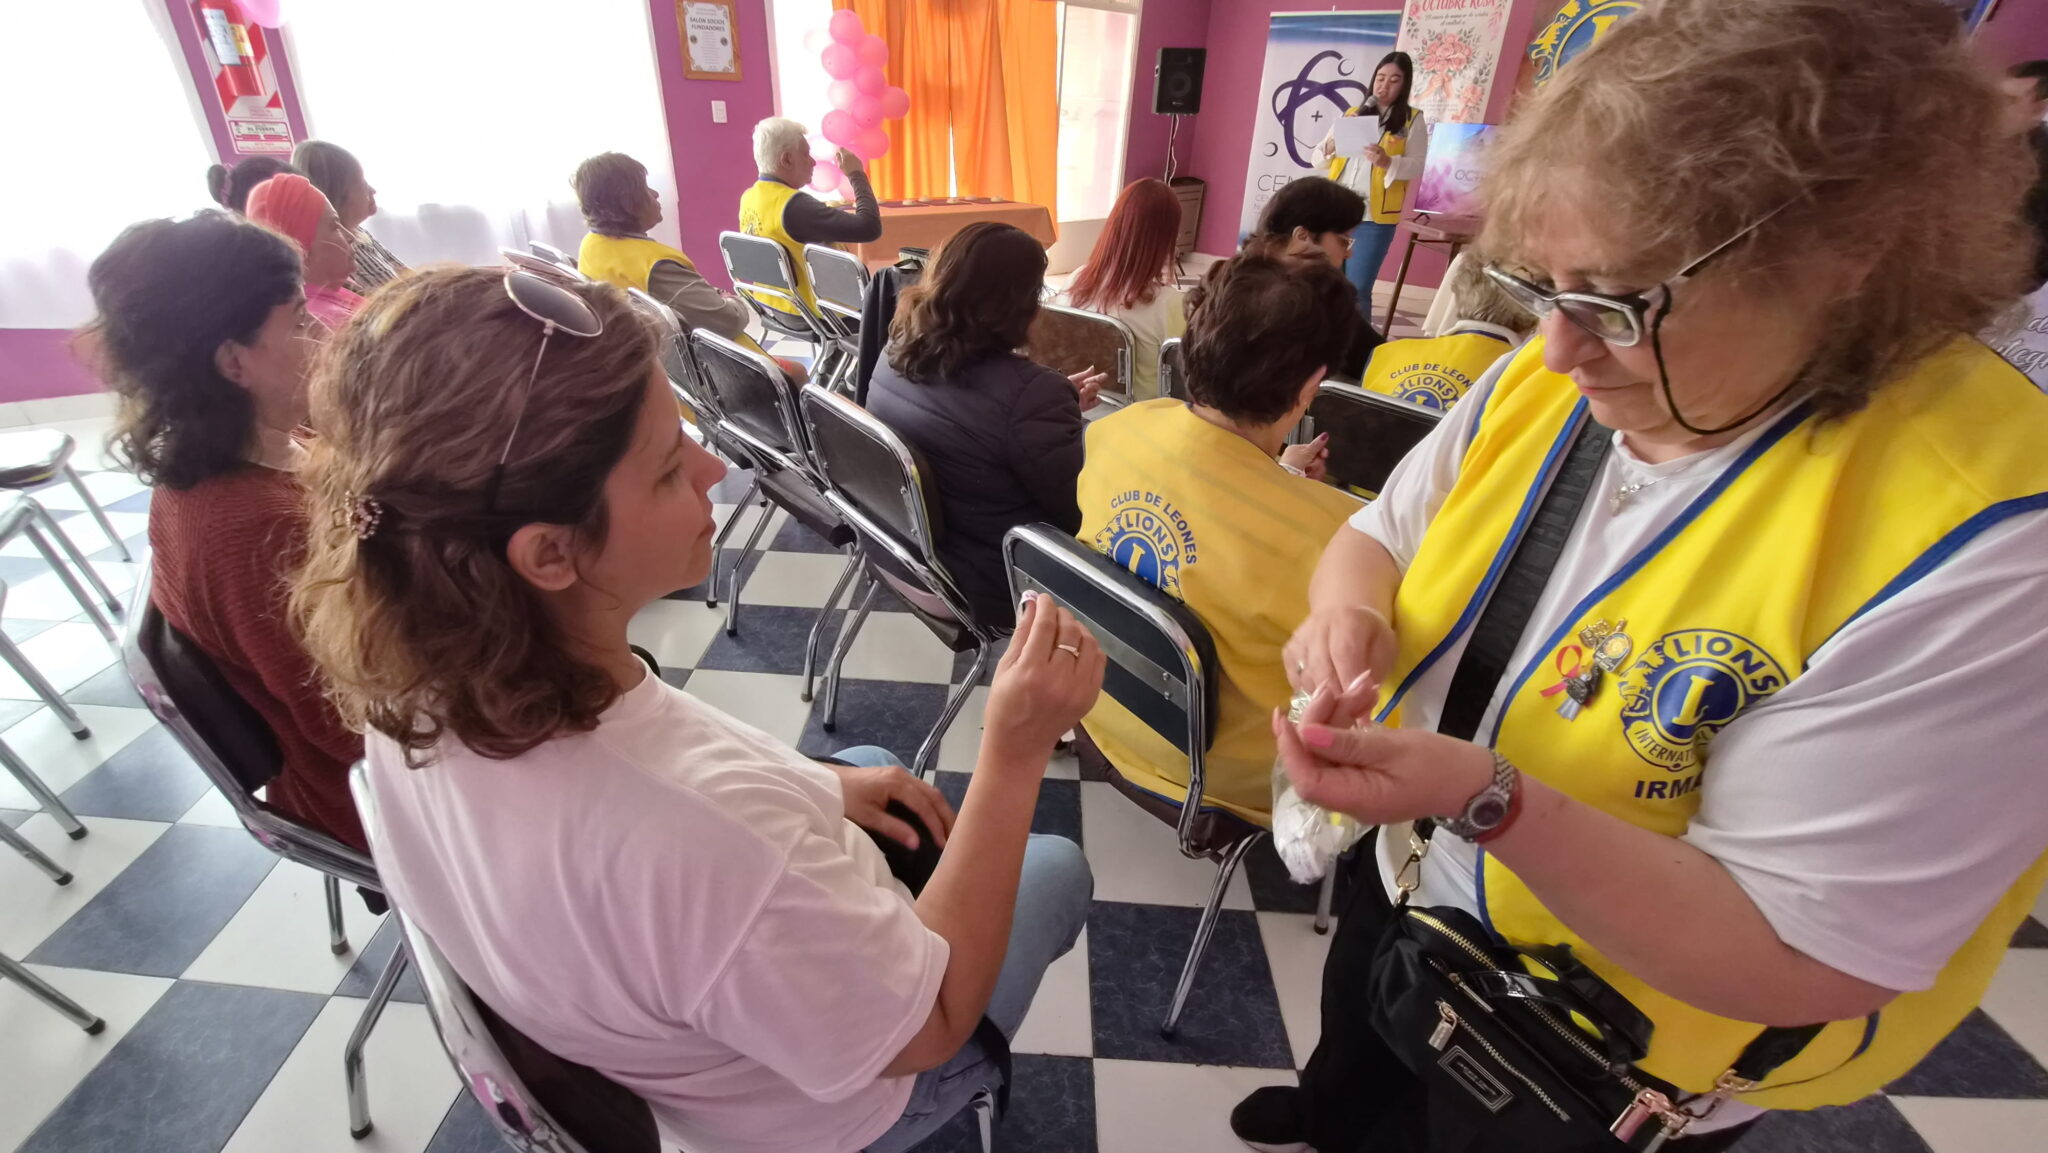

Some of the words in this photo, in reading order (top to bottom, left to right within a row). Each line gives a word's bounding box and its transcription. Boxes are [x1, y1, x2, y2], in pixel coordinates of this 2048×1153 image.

[1390, 363, 1419, 379] CLUB
[1423, 363, 1440, 371] DE
[1442, 366, 1475, 388] LEON
[1408, 376, 1454, 397] LIONS
[1111, 490, 1140, 509] CLUB
[1144, 491, 1162, 508] DE
[1163, 502, 1197, 565] LEONES
[1125, 512, 1174, 557] LIONS
[1672, 635, 1780, 692] LIONS
